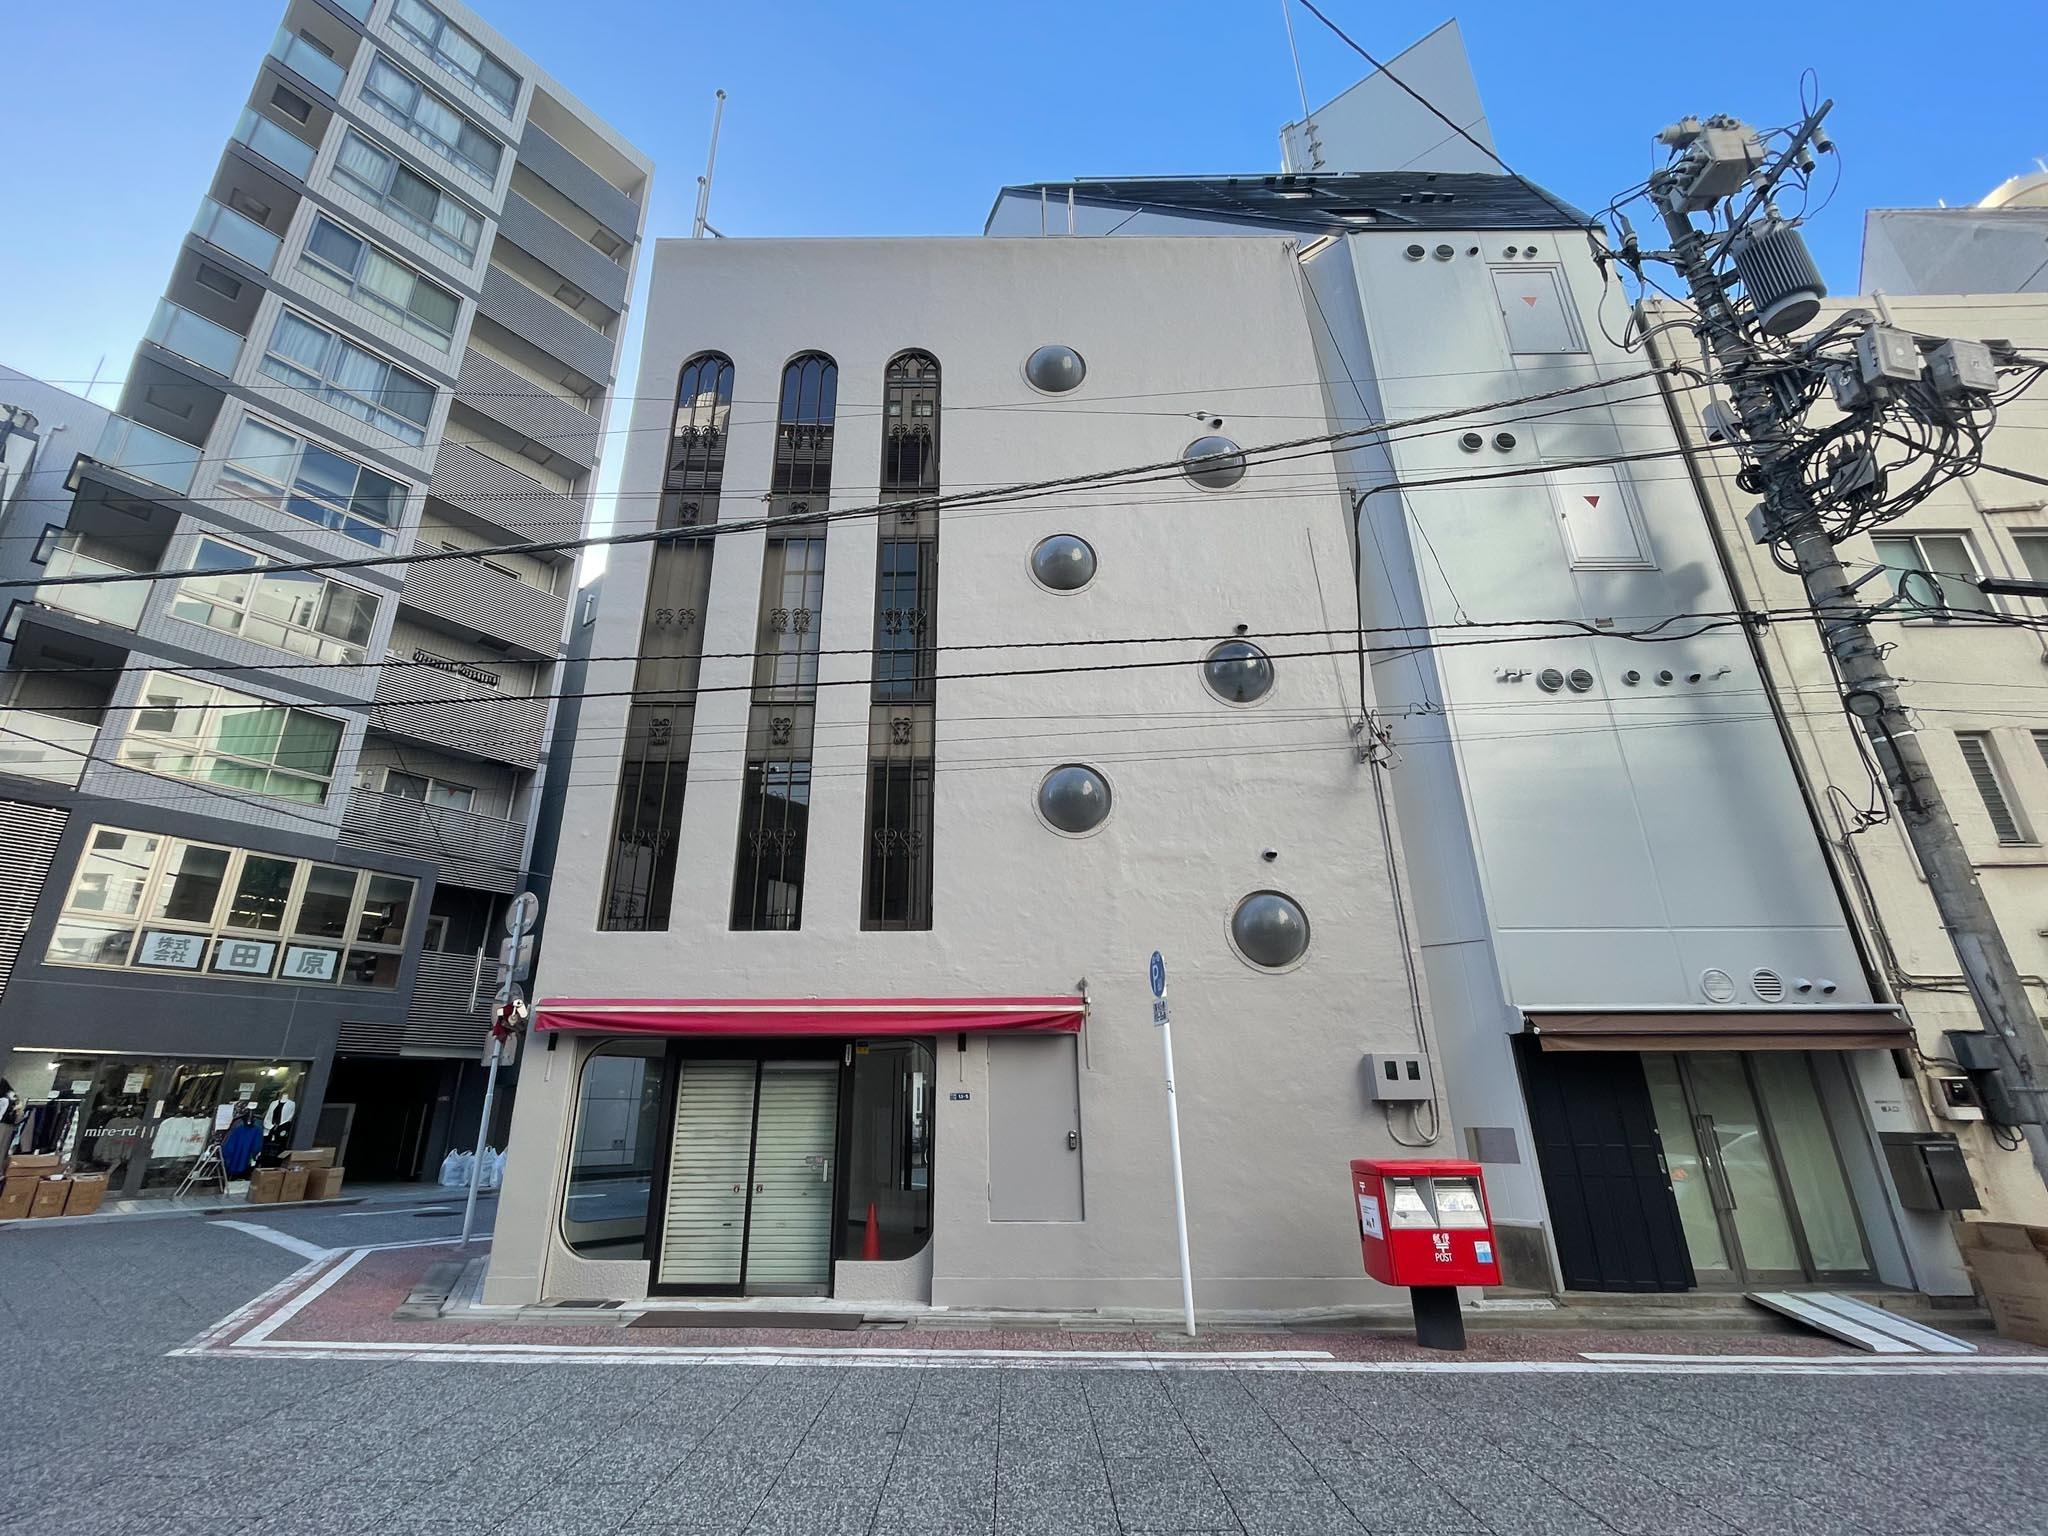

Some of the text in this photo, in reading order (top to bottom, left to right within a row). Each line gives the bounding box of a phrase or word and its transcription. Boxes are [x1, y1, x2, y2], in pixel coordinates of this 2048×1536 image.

[158, 936, 191, 950] 株式
[153, 949, 187, 963] 会社
[229, 944, 328, 975] 田 原
[1435, 1252, 1453, 1263] POST
